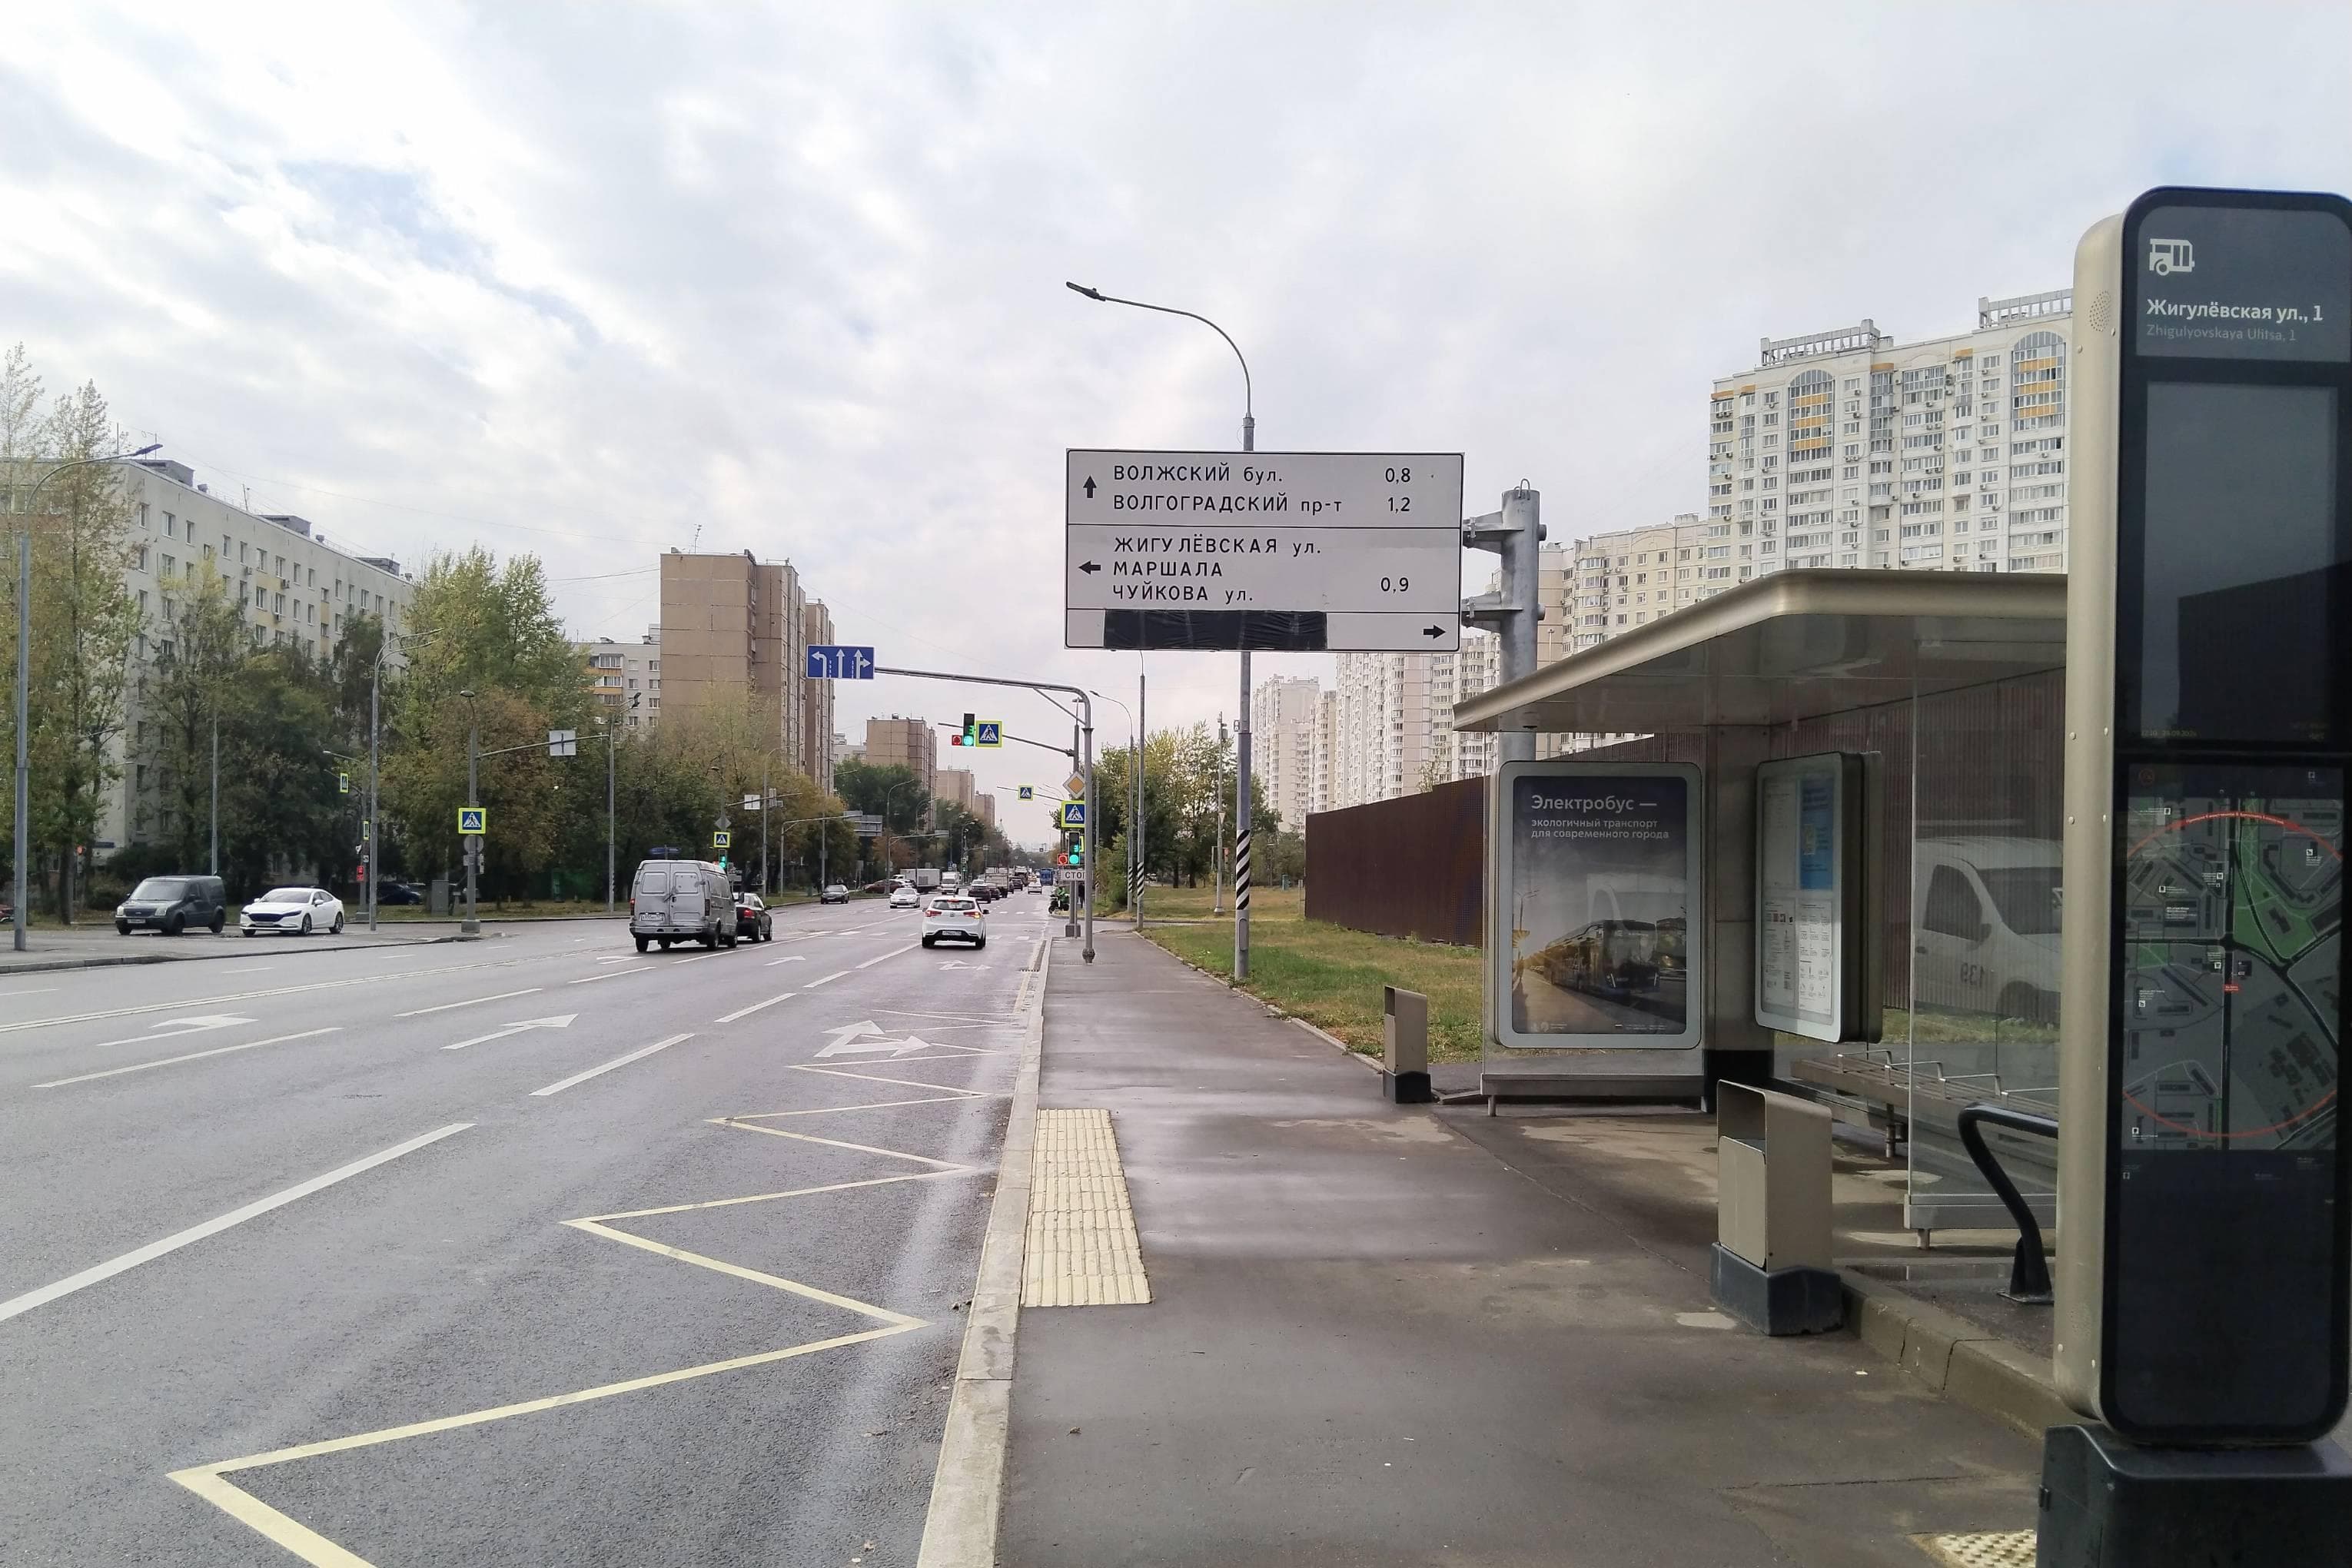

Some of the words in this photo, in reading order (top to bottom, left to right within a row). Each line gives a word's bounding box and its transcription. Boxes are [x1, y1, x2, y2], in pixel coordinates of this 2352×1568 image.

[2146, 299, 2272, 320] Жигулёвская
[2275, 307, 2308, 324] ул.,
[2312, 305, 2324, 321] 1
[2146, 324, 2244, 340] Zhigulyovskaya
[2247, 327, 2286, 342] Ulitsa,
[2289, 329, 2297, 341] 1
[1114, 462, 1230, 481] ВОЛЖСКИЙ
[1243, 467, 1283, 486] бул.
[1385, 467, 1411, 484] 0,8
[1114, 492, 1288, 513] ВОЛГОГРАДСКИЙ
[1301, 500, 1343, 516] пр-т
[1387, 497, 1410, 513] 1,2
[1114, 533, 1277, 553] ЖИГУЛЁВСКАЯ
[1292, 542, 1321, 557] ул.
[1113, 561, 1223, 576] МАРШАЛА
[1113, 581, 1208, 600] ЧУЙКОВА
[1225, 589, 1253, 604] ул.
[1380, 576, 1410, 593] 0,9
[1530, 795, 1635, 813] Электробус
[1530, 819, 1601, 828] экологичный
[1603, 819, 1658, 829] транспорт
[1530, 830, 1551, 839] для
[1553, 831, 1629, 840] современного
[1632, 832, 1669, 841] города
